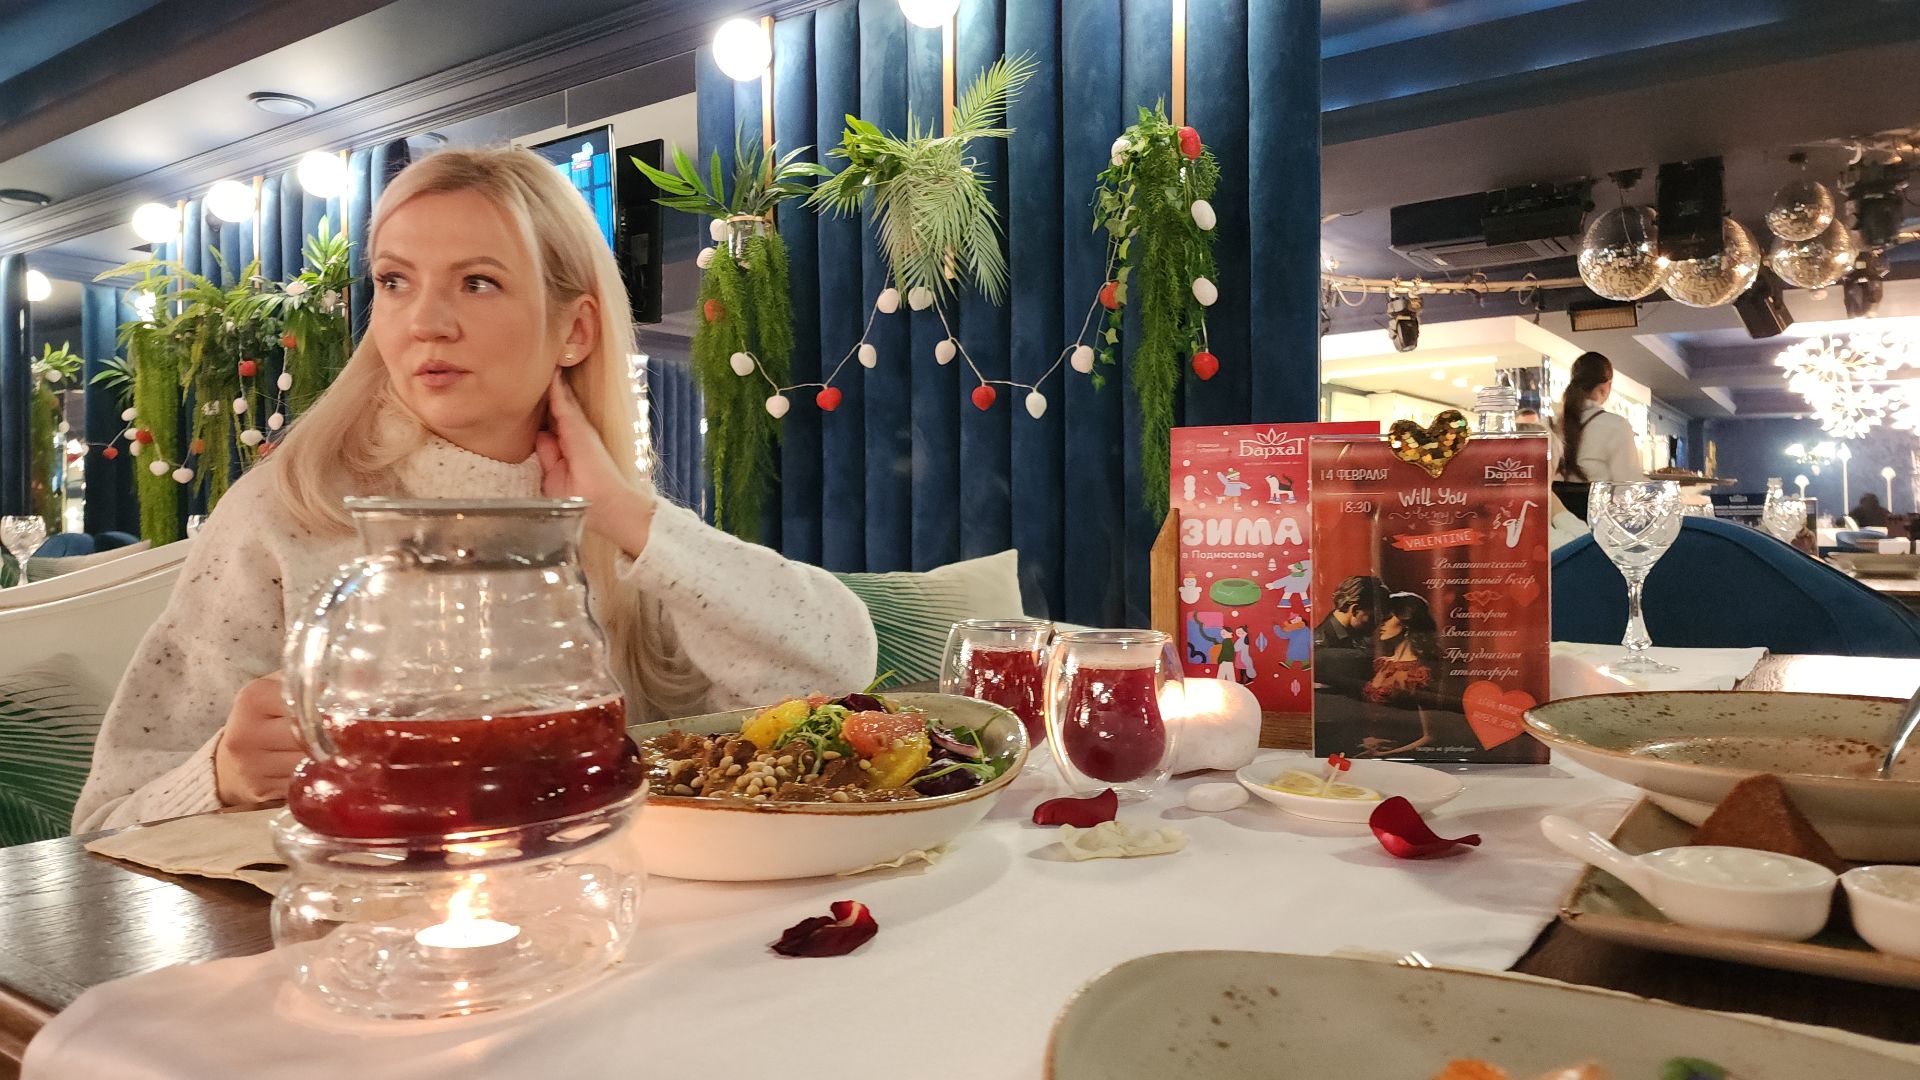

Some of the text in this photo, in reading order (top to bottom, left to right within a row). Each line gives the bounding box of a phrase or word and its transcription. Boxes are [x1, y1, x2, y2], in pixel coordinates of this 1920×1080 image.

[1320, 468, 1390, 481] 14 ФЕВРАЛЯ
[1437, 487, 1468, 506] You
[1182, 517, 1303, 547] ЗИМА
[1404, 530, 1472, 548] VALENTINE
[1191, 549, 1265, 560] Подмосковье
[1432, 558, 1527, 570] Романтический
[1421, 575, 1502, 590] музыкальный
[1449, 607, 1508, 623] Саксофон
[1440, 625, 1518, 638] Вокалистка
[1442, 647, 1522, 664] Праздничная
[1449, 667, 1519, 681] атмосфера
